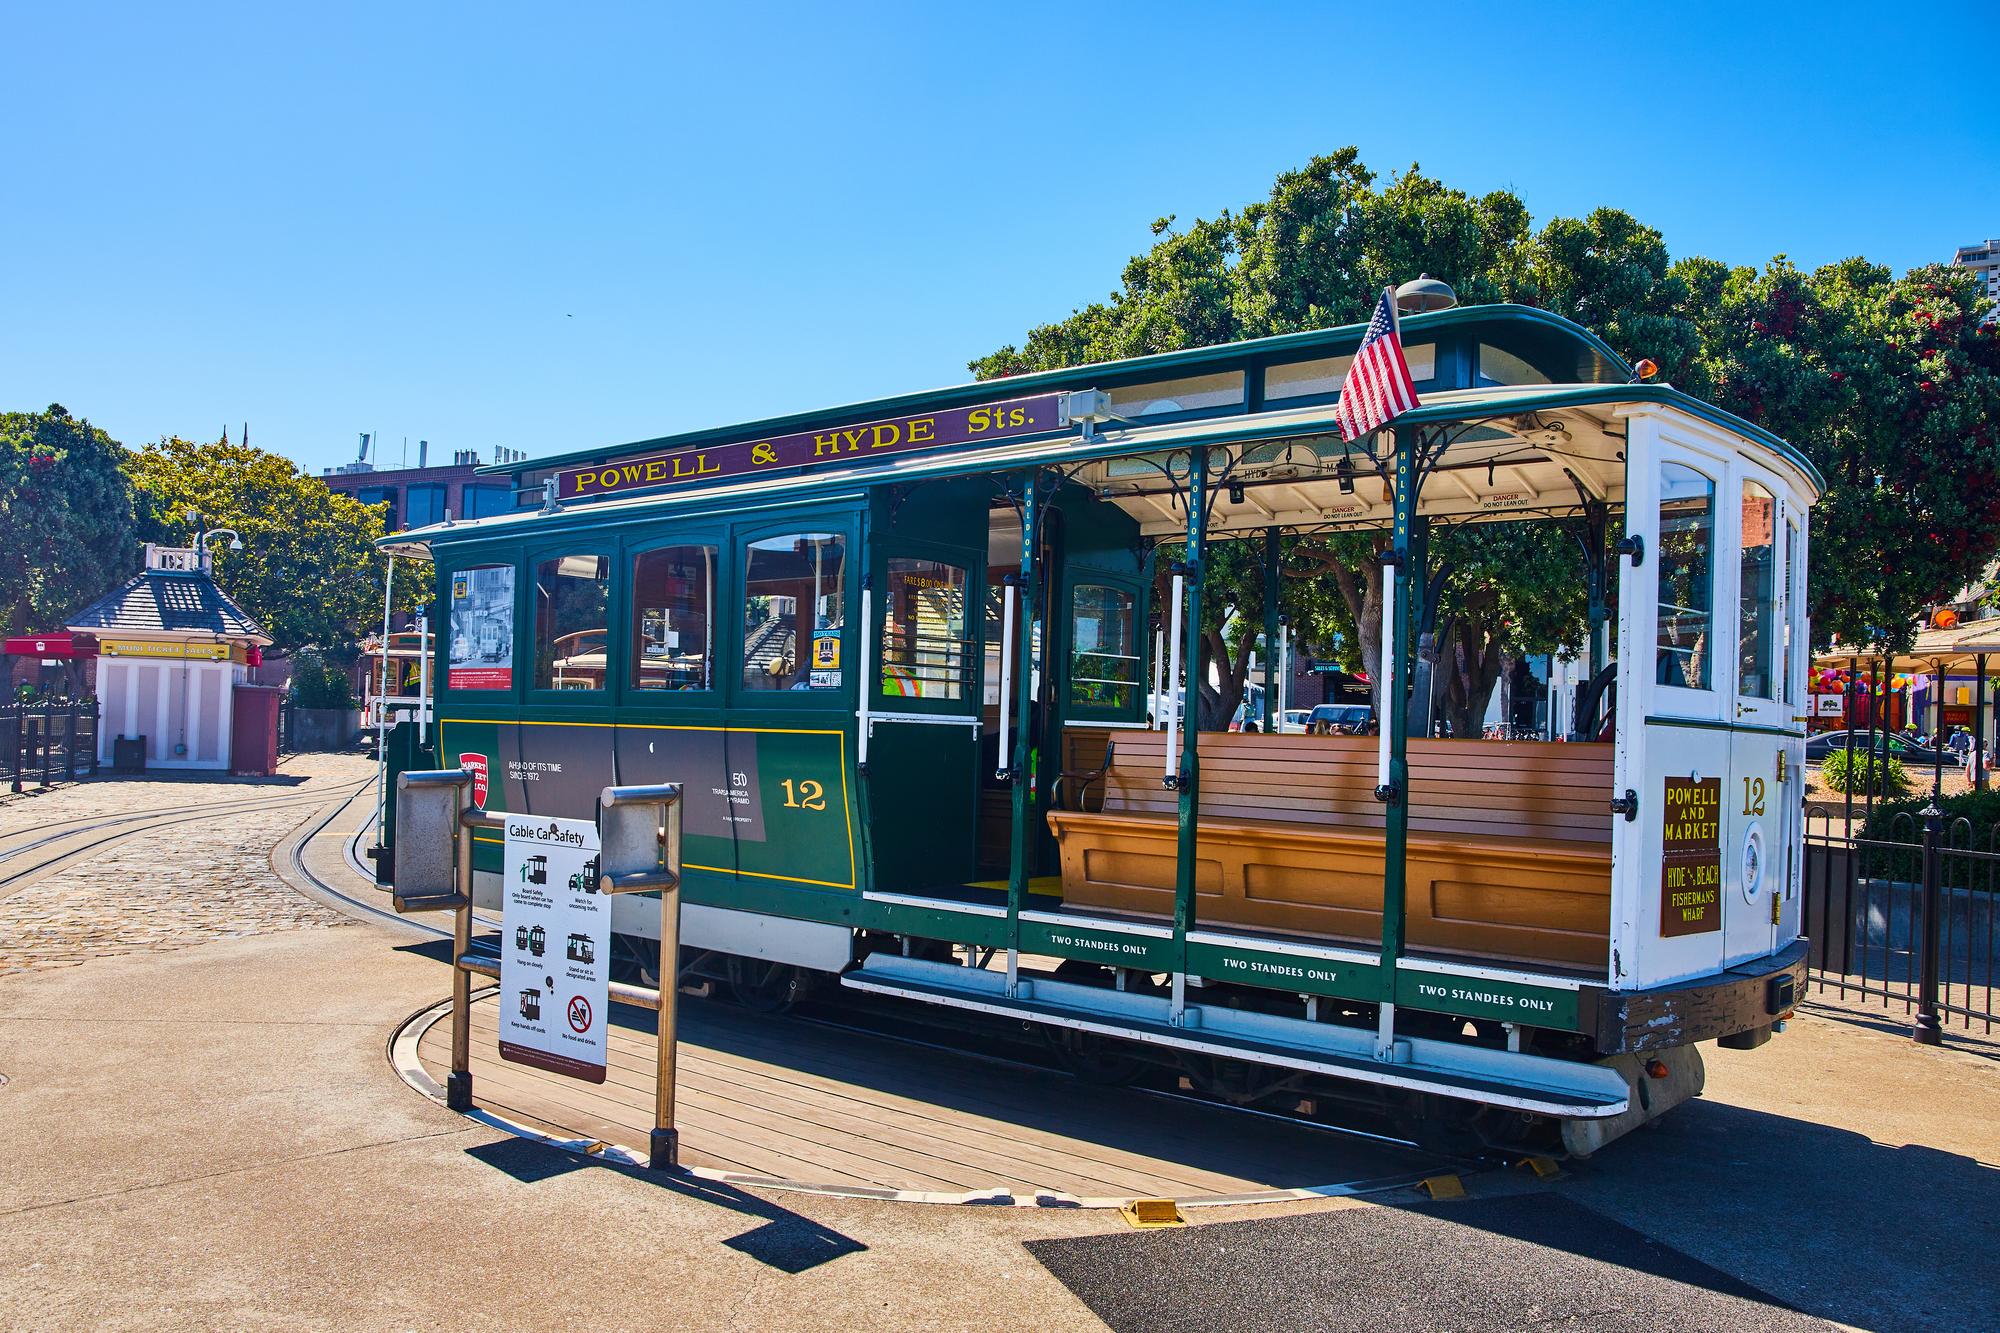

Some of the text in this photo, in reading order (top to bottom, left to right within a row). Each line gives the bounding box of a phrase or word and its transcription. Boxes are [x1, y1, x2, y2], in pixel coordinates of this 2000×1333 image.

[575, 407, 1034, 492] POWELL & HYDE Sts.
[1399, 512, 1405, 535] ON
[1191, 527, 1197, 548] ON
[1025, 538, 1030, 558] ON
[147, 645, 179, 653] TICKET
[184, 647, 213, 655] SALES
[461, 762, 486, 770] MARKET
[510, 771, 540, 780] SINCE 1972
[528, 762, 537, 770] OF
[537, 763, 546, 771] ITS
[547, 763, 562, 772] TIME
[781, 779, 826, 811] 12
[1667, 788, 1717, 805] POWELL
[1743, 777, 1765, 816] 12
[1680, 807, 1705, 820] AND
[509, 824, 584, 847] Cable Car Safety
[1665, 822, 1717, 840] MARKET
[1667, 866, 1686, 888] HYDE
[1696, 865, 1719, 885] BEACH
[1672, 890, 1715, 907] FISHERMANS
[1682, 906, 1704, 922] WHARF
[1051, 935, 1147, 955] TWO STANDEES ONLY
[1223, 958, 1337, 982] TWO STANDEES ONLY
[1418, 984, 1554, 1011] TWO STANDEES ONLY
